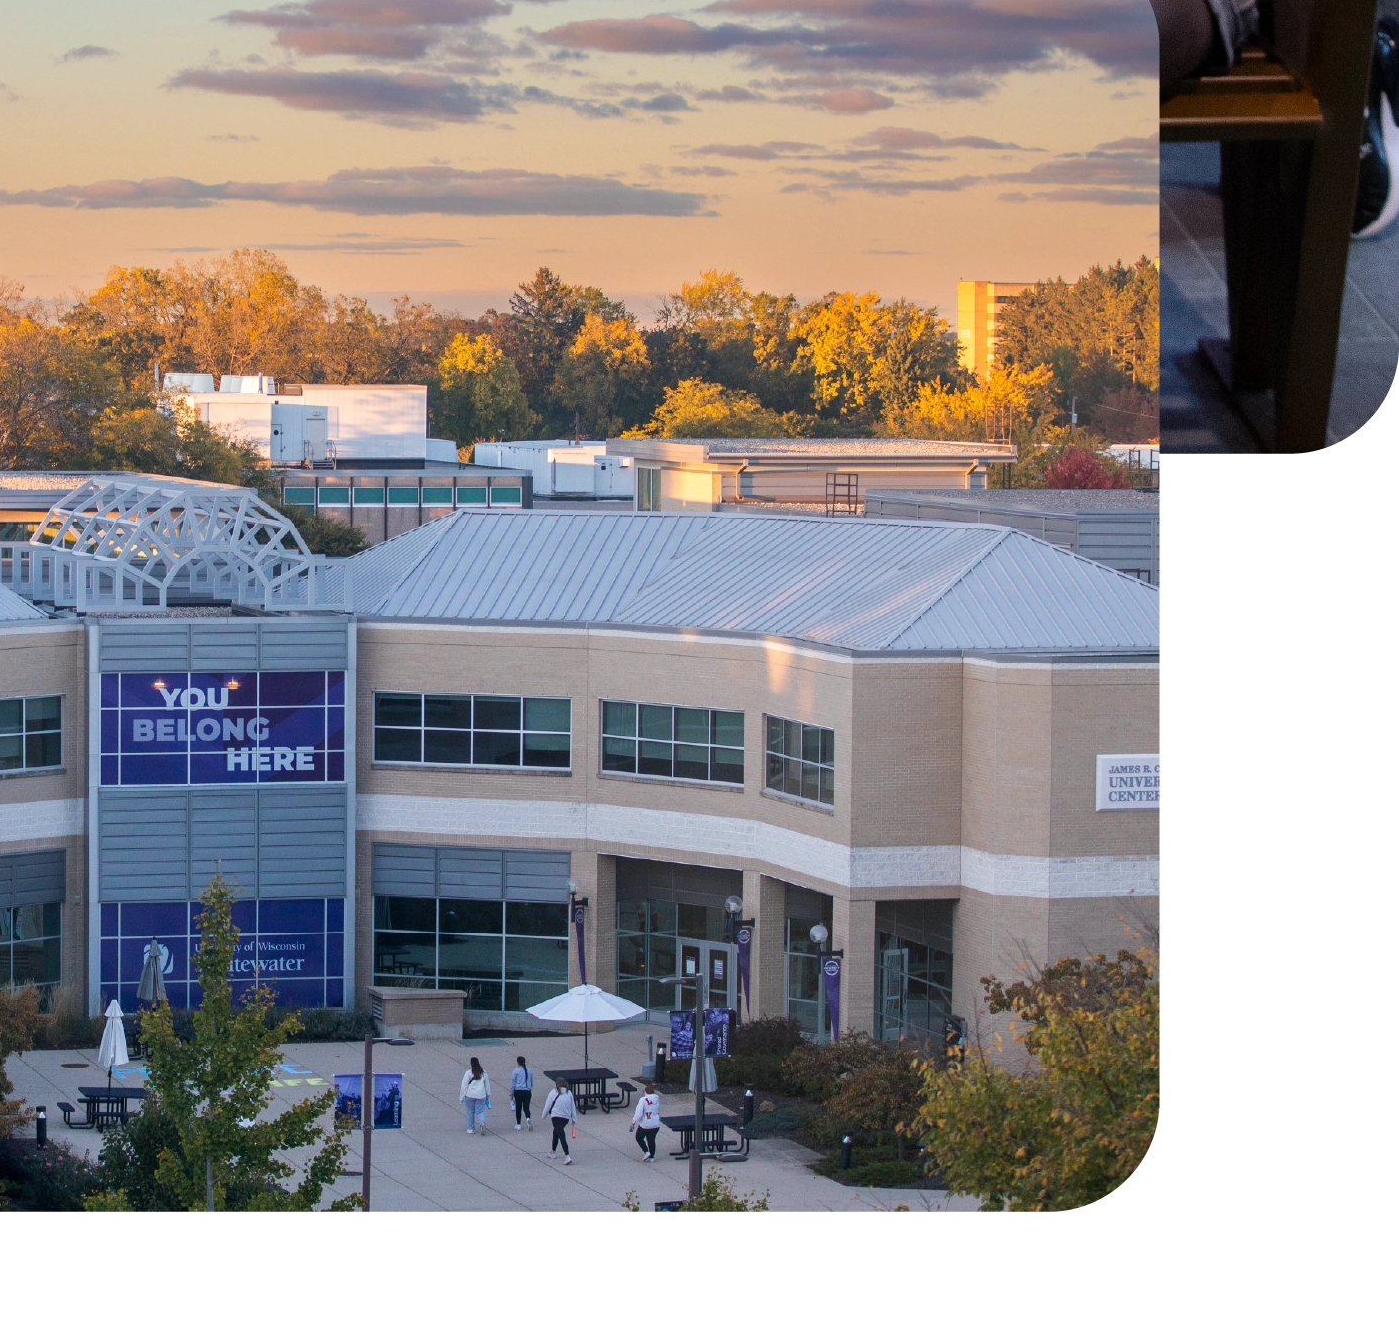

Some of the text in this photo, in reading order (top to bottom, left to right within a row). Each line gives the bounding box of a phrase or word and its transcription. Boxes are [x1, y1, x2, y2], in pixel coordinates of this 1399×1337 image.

[159, 686, 230, 712] YOU
[132, 716, 271, 743] BELONG
[226, 746, 316, 772] HERE
[1108, 765, 1141, 775] JAMES
[1143, 765, 1152, 774] R.
[244, 941, 254, 953] of
[258, 940, 306, 952] Wisconsin
[393, 1100, 401, 1126] Learning
